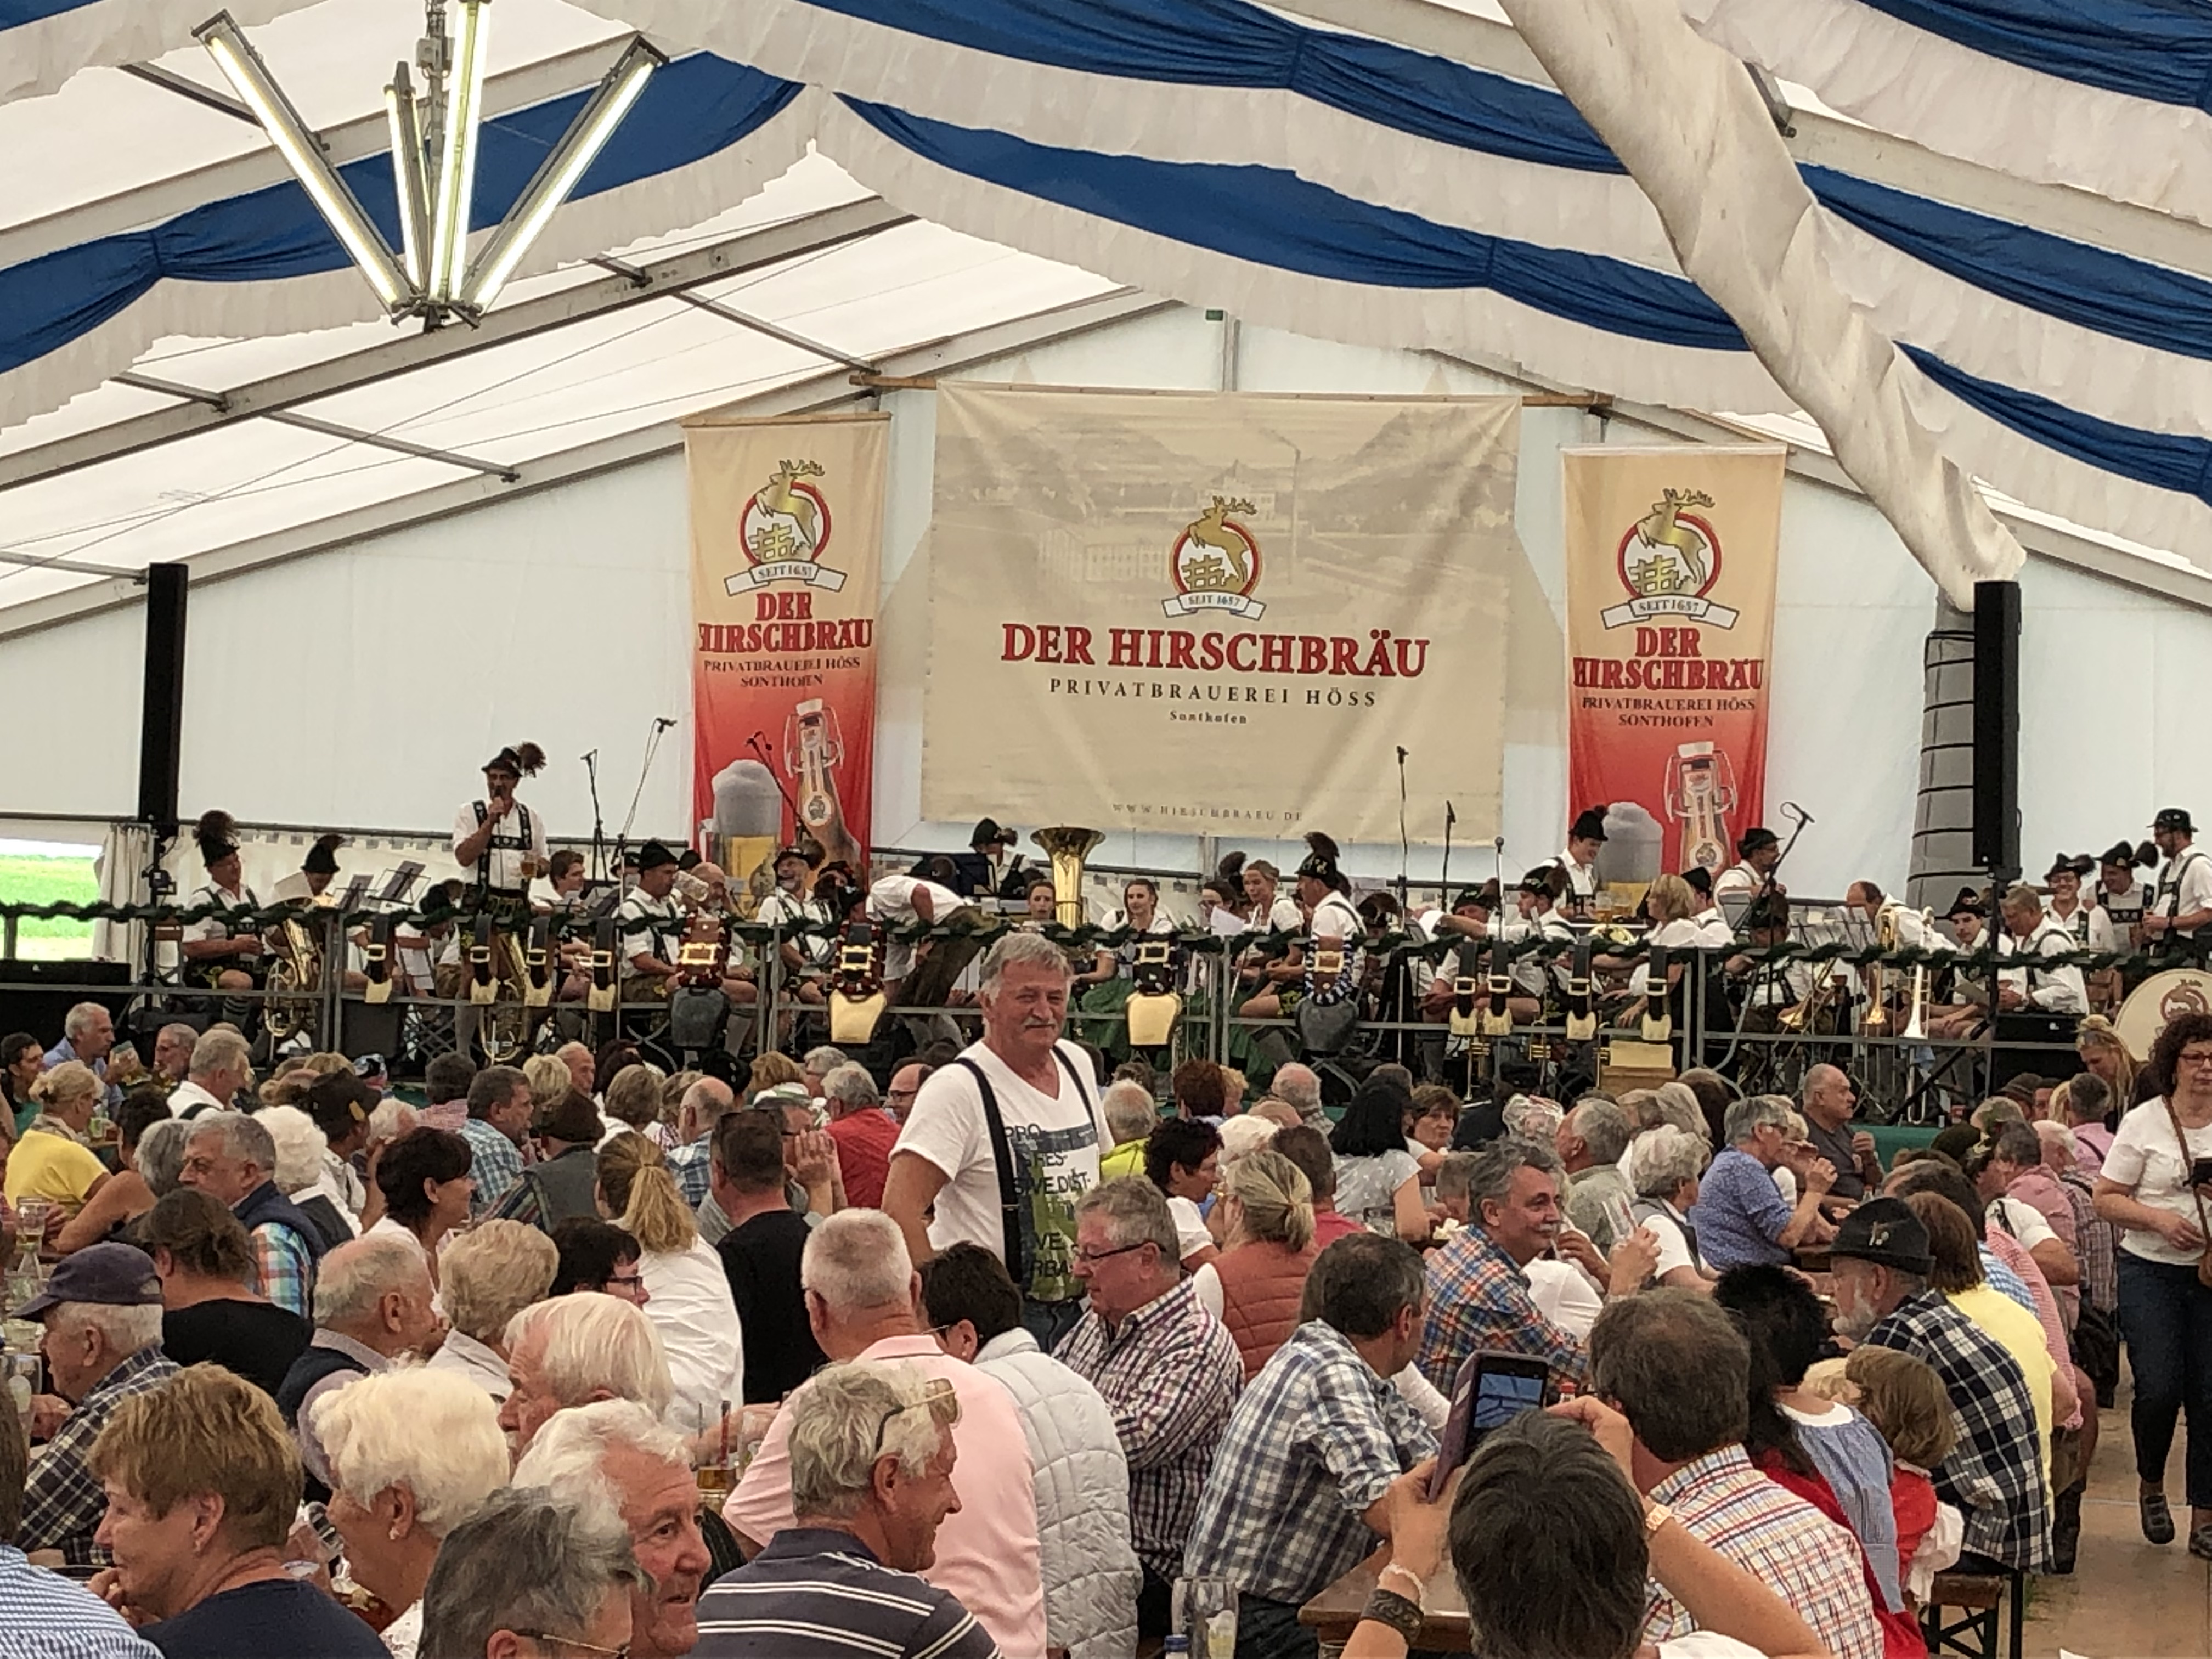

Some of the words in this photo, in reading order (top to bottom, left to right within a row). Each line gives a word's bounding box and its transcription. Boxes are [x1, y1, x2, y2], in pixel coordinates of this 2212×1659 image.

[755, 592, 812, 620] DER
[1188, 595, 1213, 605] SEIT
[1001, 623, 1095, 665] DER
[1108, 629, 1430, 678] HIRSCHBRÄU
[1635, 627, 1702, 658] DER
[826, 656, 860, 669] HÖSS
[1573, 657, 1764, 691] HIRSCHBRÄU
[1051, 678, 1288, 704] PRIVATBRAUEREI
[1306, 687, 1375, 707] HÖSS
[1582, 697, 1712, 711] PRIVATBRAUEREI
[1716, 696, 1755, 711] HÖSS
[1170, 710, 1246, 724] Sonthofen
[1618, 714, 1714, 727] SONTHOFEN
